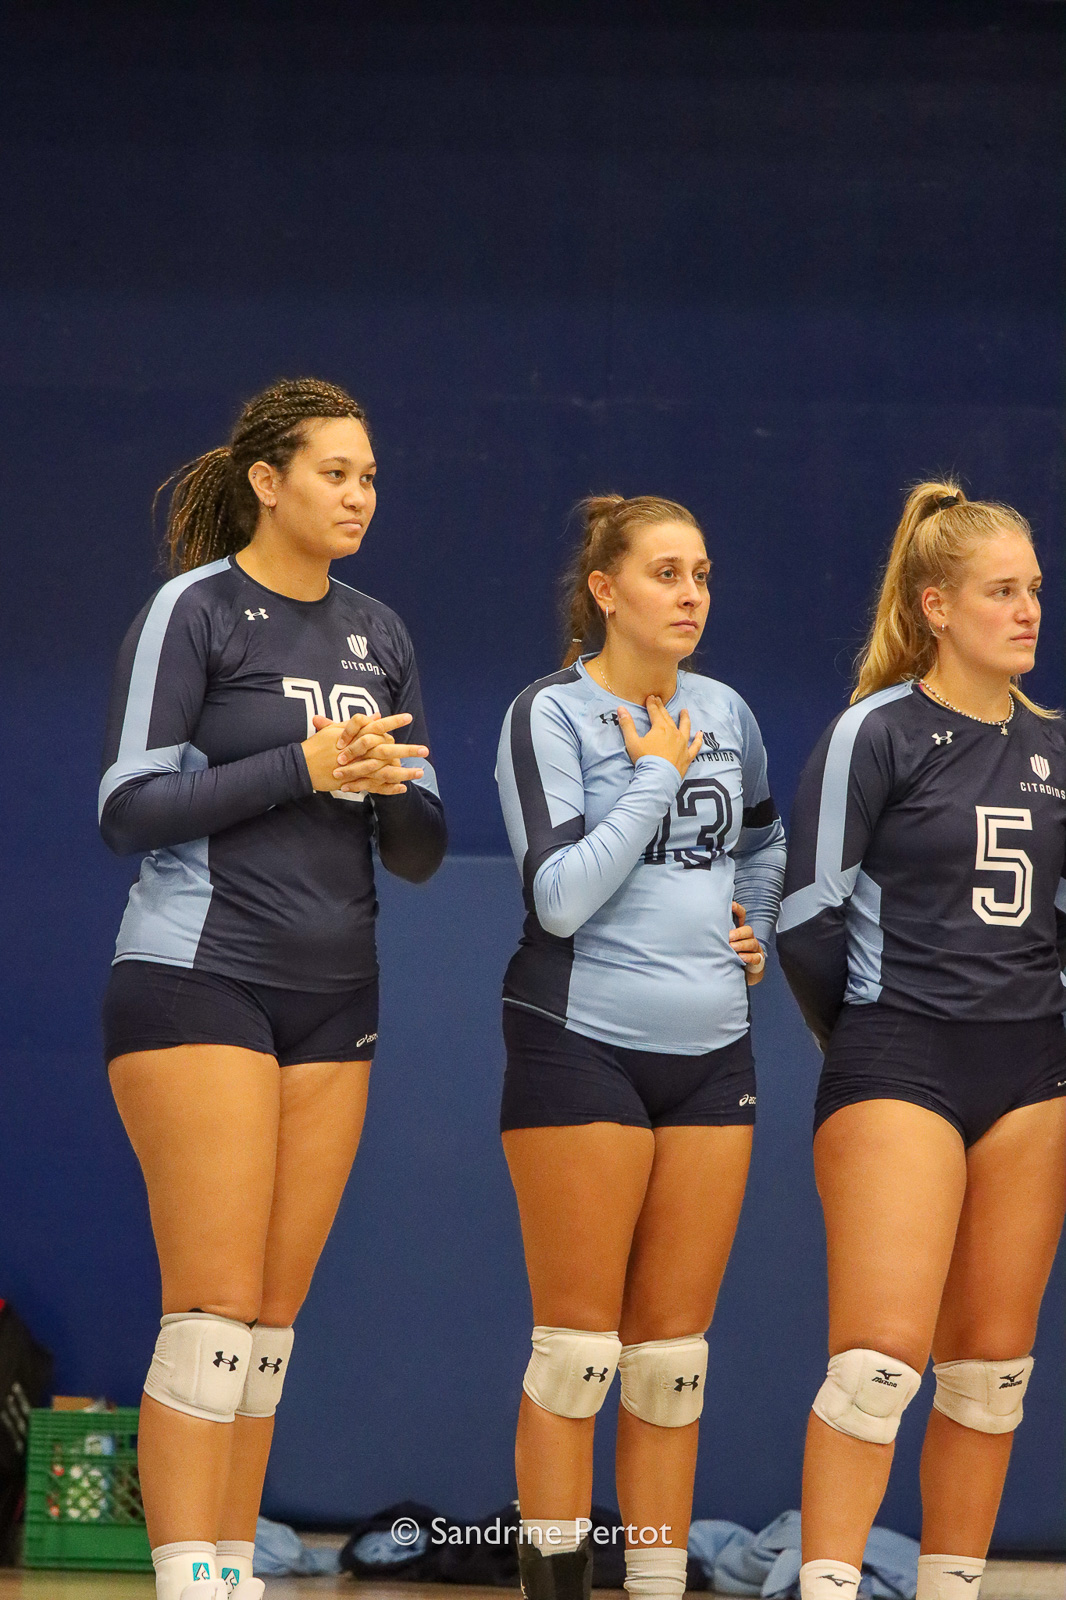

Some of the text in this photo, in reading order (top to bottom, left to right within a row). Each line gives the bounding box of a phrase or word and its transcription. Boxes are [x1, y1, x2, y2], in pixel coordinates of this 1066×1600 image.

[340, 659, 386, 676] CITADN
[691, 752, 734, 763] ITADINS
[1019, 781, 1066, 800] CITADINS
[972, 806, 1034, 928] 5
